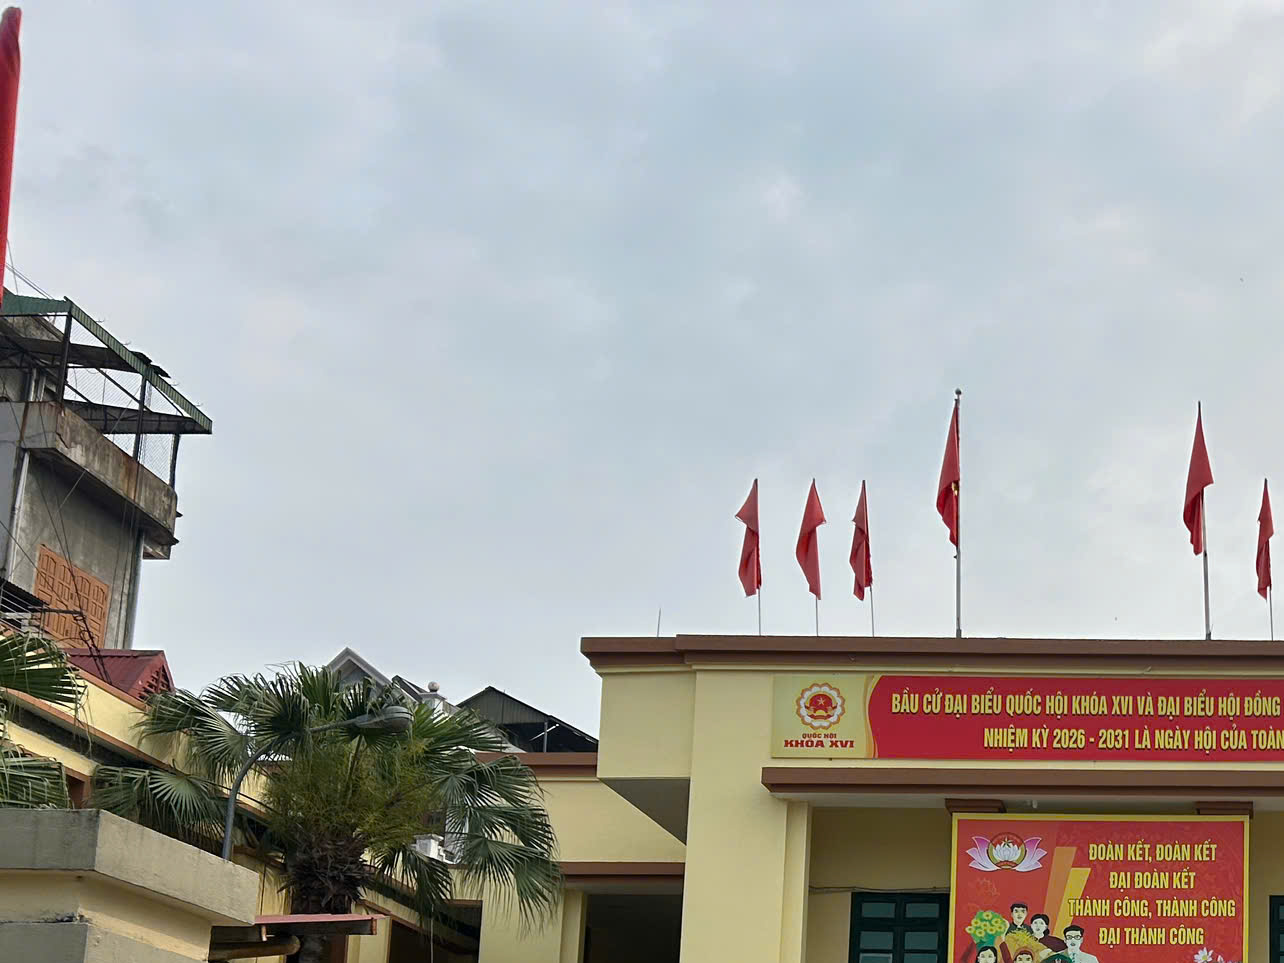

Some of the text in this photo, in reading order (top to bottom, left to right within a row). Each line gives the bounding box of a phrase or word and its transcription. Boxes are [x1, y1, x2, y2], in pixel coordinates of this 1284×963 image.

[892, 687, 919, 714] BẦU
[923, 687, 942, 714] CỬ
[945, 694, 967, 719] ĐẠI
[972, 686, 1002, 714] BIỂU
[1005, 688, 1041, 717] QUỐC
[1046, 691, 1068, 719] HỘI
[1072, 691, 1108, 715] KHÓA
[1111, 696, 1133, 715] XVI
[1137, 692, 1154, 716] VÀ
[1158, 696, 1180, 720] ĐẠI
[1184, 689, 1214, 716] BIỂU
[1218, 693, 1240, 721] HỘI
[1244, 690, 1281, 716] ĐỒNG
[784, 738, 855, 748] KHÓA XVI
[984, 724, 1028, 752] NHIỆM
[1032, 725, 1049, 749] KỲ
[1053, 729, 1086, 749] 2026
[1098, 729, 1130, 749] 2031
[1135, 725, 1151, 749] LÀ
[1155, 726, 1191, 749] NGÀY
[1195, 726, 1216, 754] HỘI
[1220, 724, 1247, 749] CỦA
[1089, 838, 1217, 863] ĐOÀN KẾT, ĐOÀN KẾT
[1109, 867, 1196, 893] ĐẠI ĐOÀN KẾT
[1068, 895, 1236, 919] THÀNH CÔNG, THÀNH CÔNG
[1099, 924, 1205, 948] ĐẠI THÀNH CÔNG
